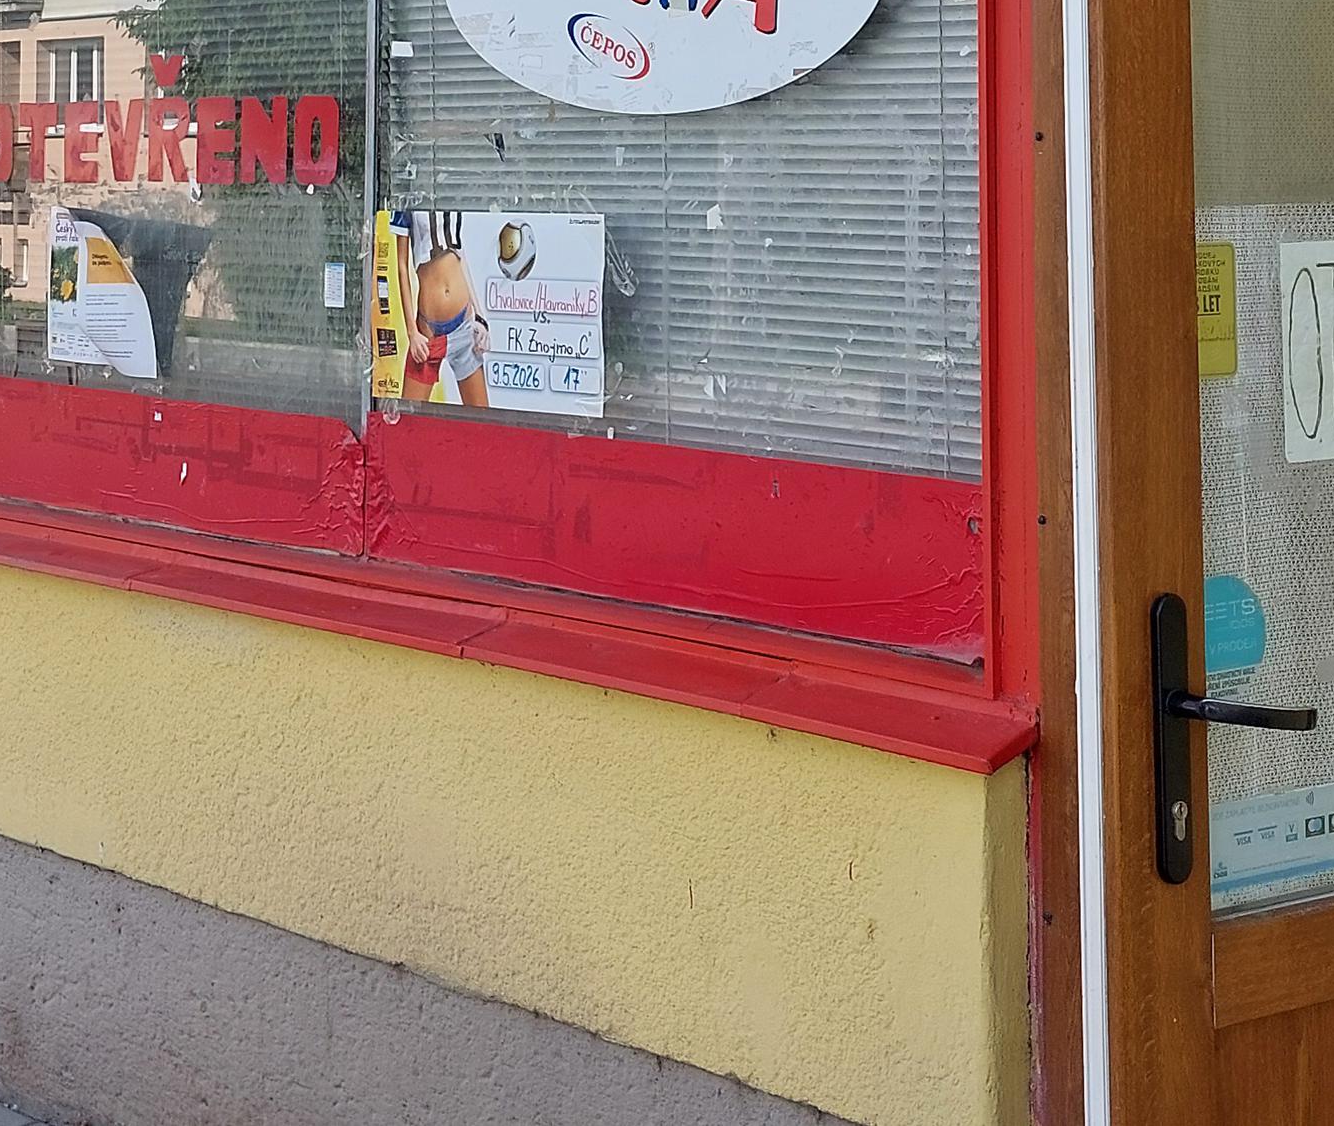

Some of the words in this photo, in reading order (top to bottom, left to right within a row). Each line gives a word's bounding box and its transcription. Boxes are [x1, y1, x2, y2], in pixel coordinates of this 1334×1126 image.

[580, 21, 637, 69] ČEPOS
[1202, 294, 1221, 312] LET
[508, 327, 523, 352] FK
[528, 328, 574, 363] Znojmo
[492, 362, 540, 388] 9.5.2026
[1204, 597, 1255, 621] EETS
[1235, 836, 1252, 846] VISA
